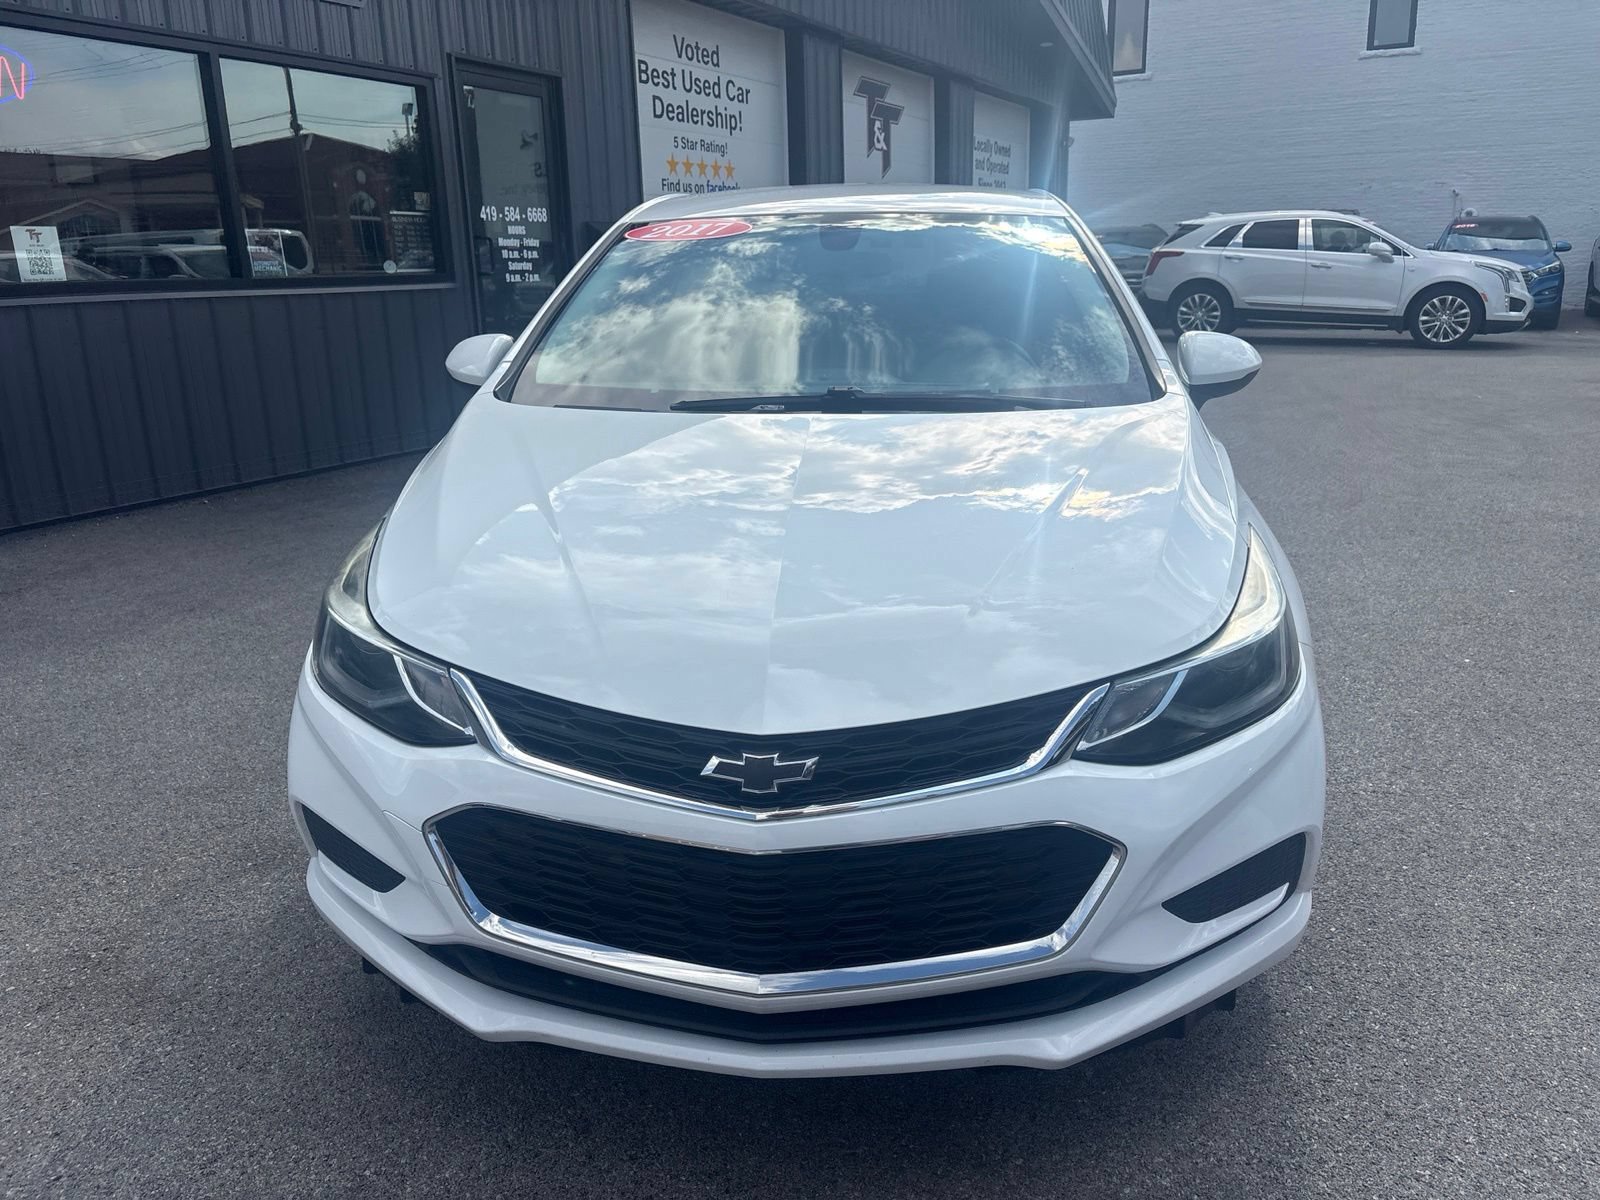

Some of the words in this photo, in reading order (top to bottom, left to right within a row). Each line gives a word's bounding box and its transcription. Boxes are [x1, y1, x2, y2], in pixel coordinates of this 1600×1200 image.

[673, 34, 720, 68] Voted
[638, 59, 677, 91] Best
[682, 69, 721, 99] Used
[726, 80, 751, 104] Car
[652, 94, 742, 136] Dealership!
[673, 136, 679, 149] 5
[681, 137, 698, 151] Star
[700, 139, 728, 157] Rating!
[994, 141, 1011, 158] Owned
[975, 157, 985, 171] and
[986, 158, 1009, 175] Operated
[661, 178, 680, 192] Find
[682, 182, 692, 193] us
[694, 183, 705, 194] on
[480, 205, 497, 221] 419
[504, 206, 520, 221] 584
[527, 207, 548, 222] 6668
[507, 225, 526, 235] HOURS
[641, 222, 734, 238] 2017
[498, 237, 520, 248] Monday
[523, 238, 540, 248] Friday
[508, 261, 533, 271] Saturday
[505, 273, 510, 282] 9
